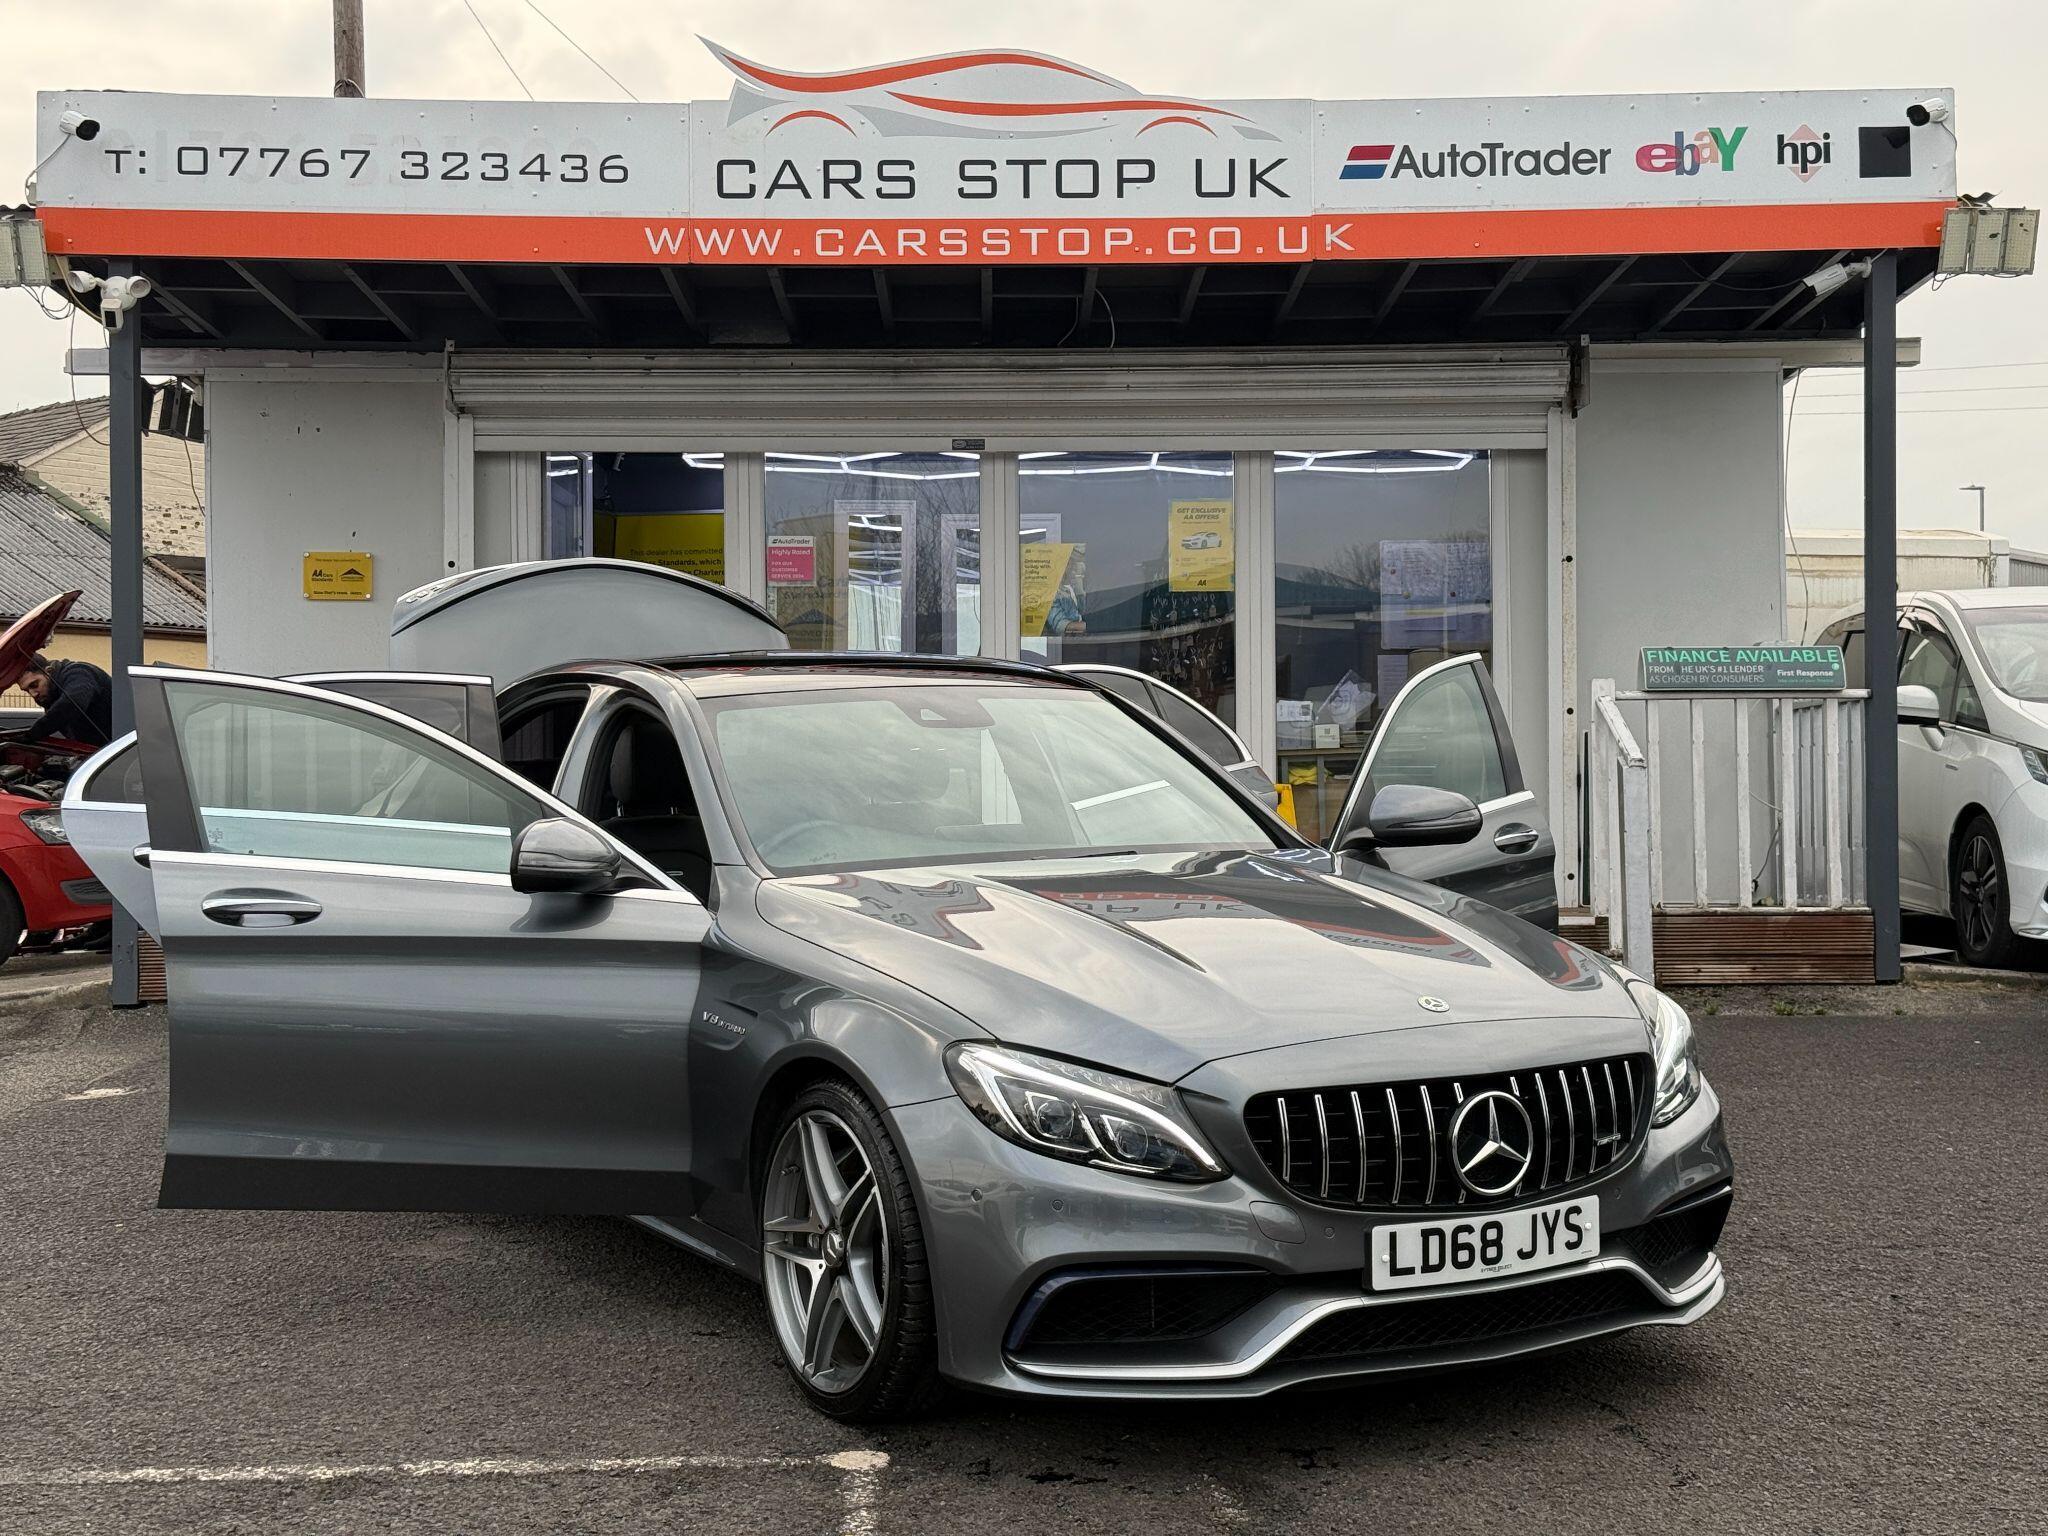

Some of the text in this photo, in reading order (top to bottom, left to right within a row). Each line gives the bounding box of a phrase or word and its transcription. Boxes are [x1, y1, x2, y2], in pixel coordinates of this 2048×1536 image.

[1391, 141, 1612, 179] AutoTrader
[1776, 131, 1831, 174] hpi
[104, 148, 147, 176] T:
[177, 145, 371, 180] 07767
[400, 150, 630, 185] 323436
[716, 157, 1291, 200] CARS STOP UK
[644, 223, 1356, 257] WWW.CARSSTOP.CO.UK
[670, 548, 683, 556] has
[684, 547, 723, 555] committed
[699, 558, 722, 566] which
[1646, 649, 1840, 663] FINANCE AVAILABLE
[1649, 665, 1674, 674] FROM
[1695, 665, 1716, 674] UK'S
[1717, 665, 1727, 674] #1
[1729, 665, 1764, 674] LENDER
[1649, 674, 1766, 684] AS CHOSEN BY CONSUMERS
[1776, 669, 1834, 678] First Response
[1388, 1205, 1584, 1278] LD68 JYS
